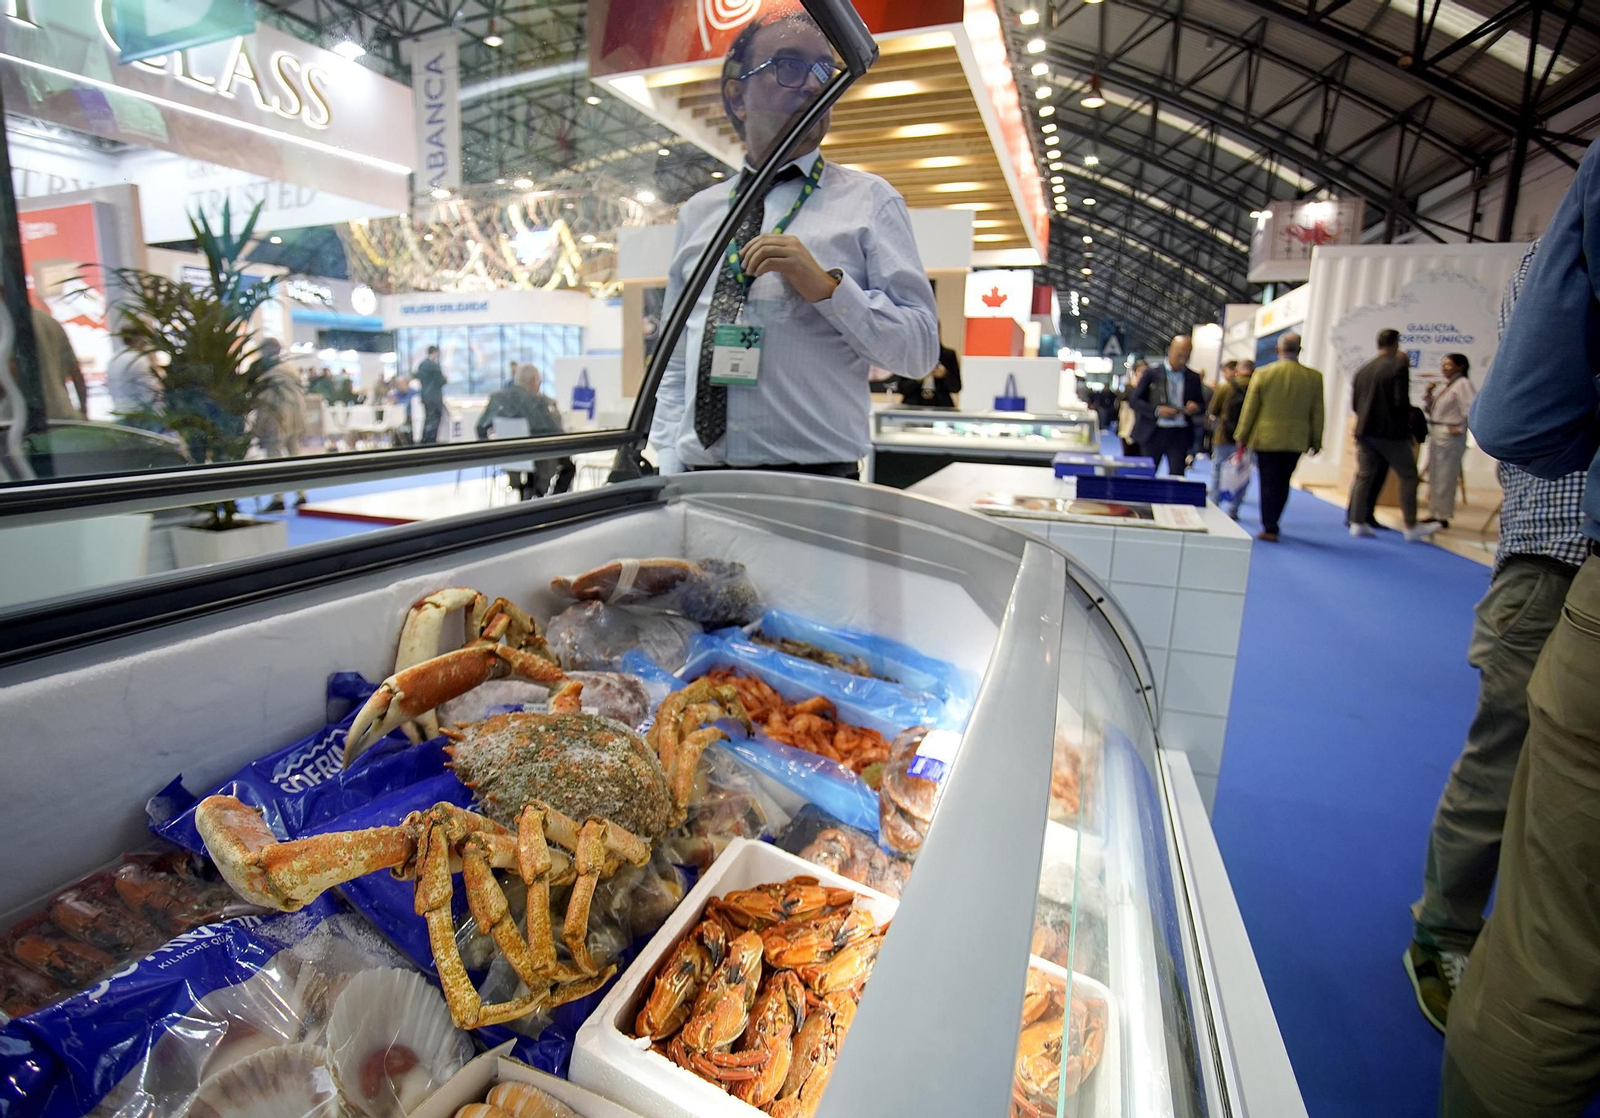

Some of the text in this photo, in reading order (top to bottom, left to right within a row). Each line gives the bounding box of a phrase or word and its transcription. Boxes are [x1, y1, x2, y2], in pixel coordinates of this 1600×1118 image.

[424, 52, 447, 190] ABANCA
[1398, 333, 1431, 344] ORTO
[158, 940, 209, 970] KILMORE
[211, 928, 235, 946] QUAY
